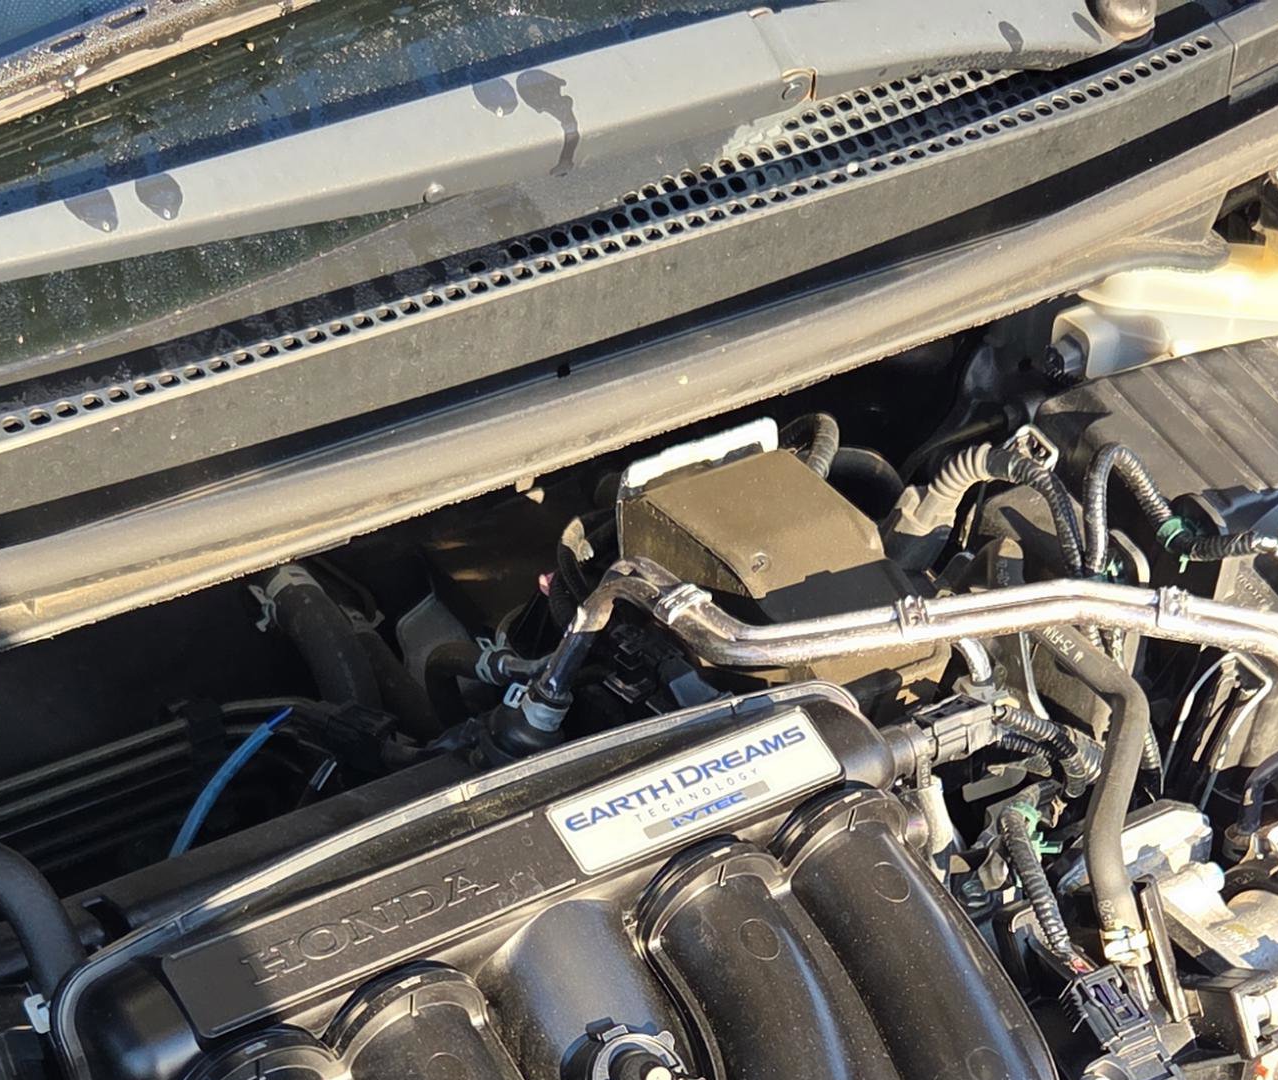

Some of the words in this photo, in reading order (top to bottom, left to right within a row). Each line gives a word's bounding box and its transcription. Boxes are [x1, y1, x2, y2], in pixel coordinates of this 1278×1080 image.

[565, 778, 674, 832] EARTH
[672, 725, 807, 790] DREAMS
[635, 767, 759, 823] TECHNOLOGY
[240, 868, 501, 986] HONDA
